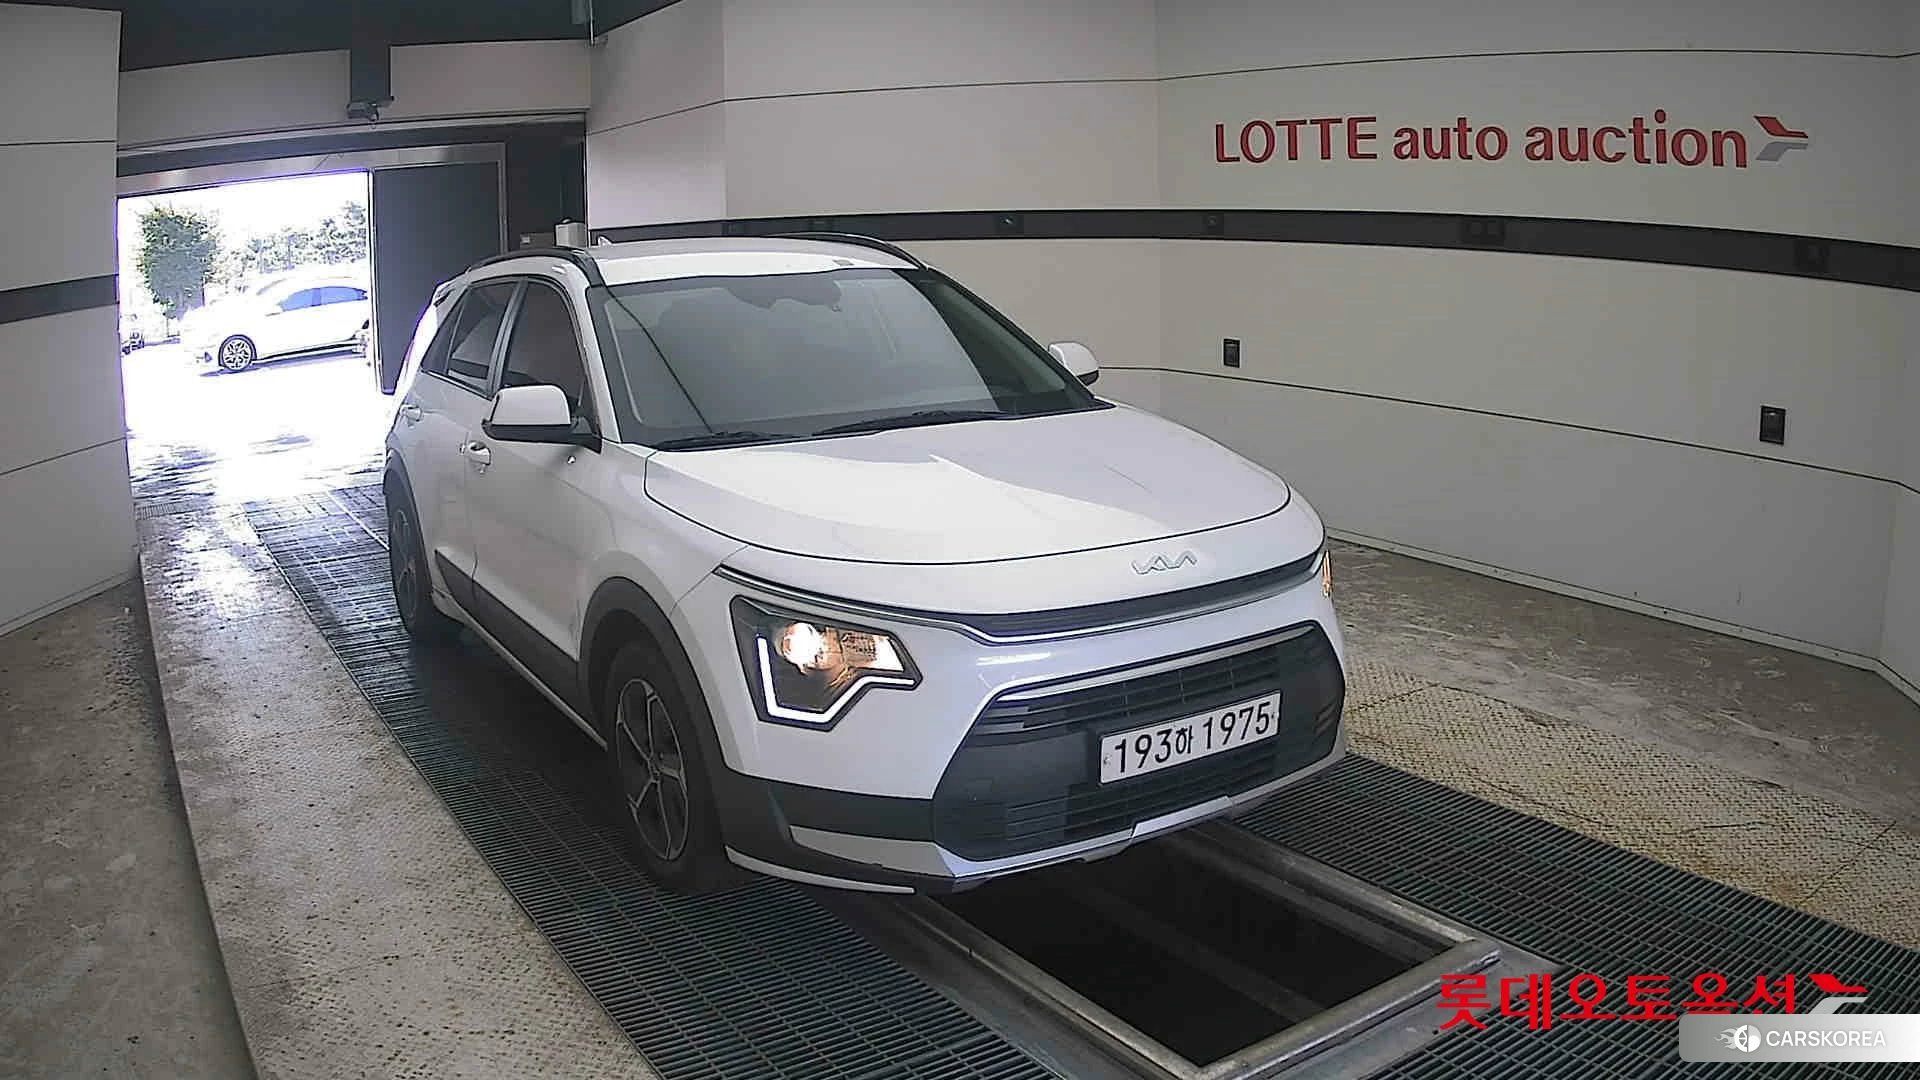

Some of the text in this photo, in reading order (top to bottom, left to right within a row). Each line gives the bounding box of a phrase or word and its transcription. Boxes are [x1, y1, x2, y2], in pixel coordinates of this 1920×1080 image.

[1215, 109, 1748, 168] LOTTE auto auction
[1114, 701, 1271, 774] 193하 1975
